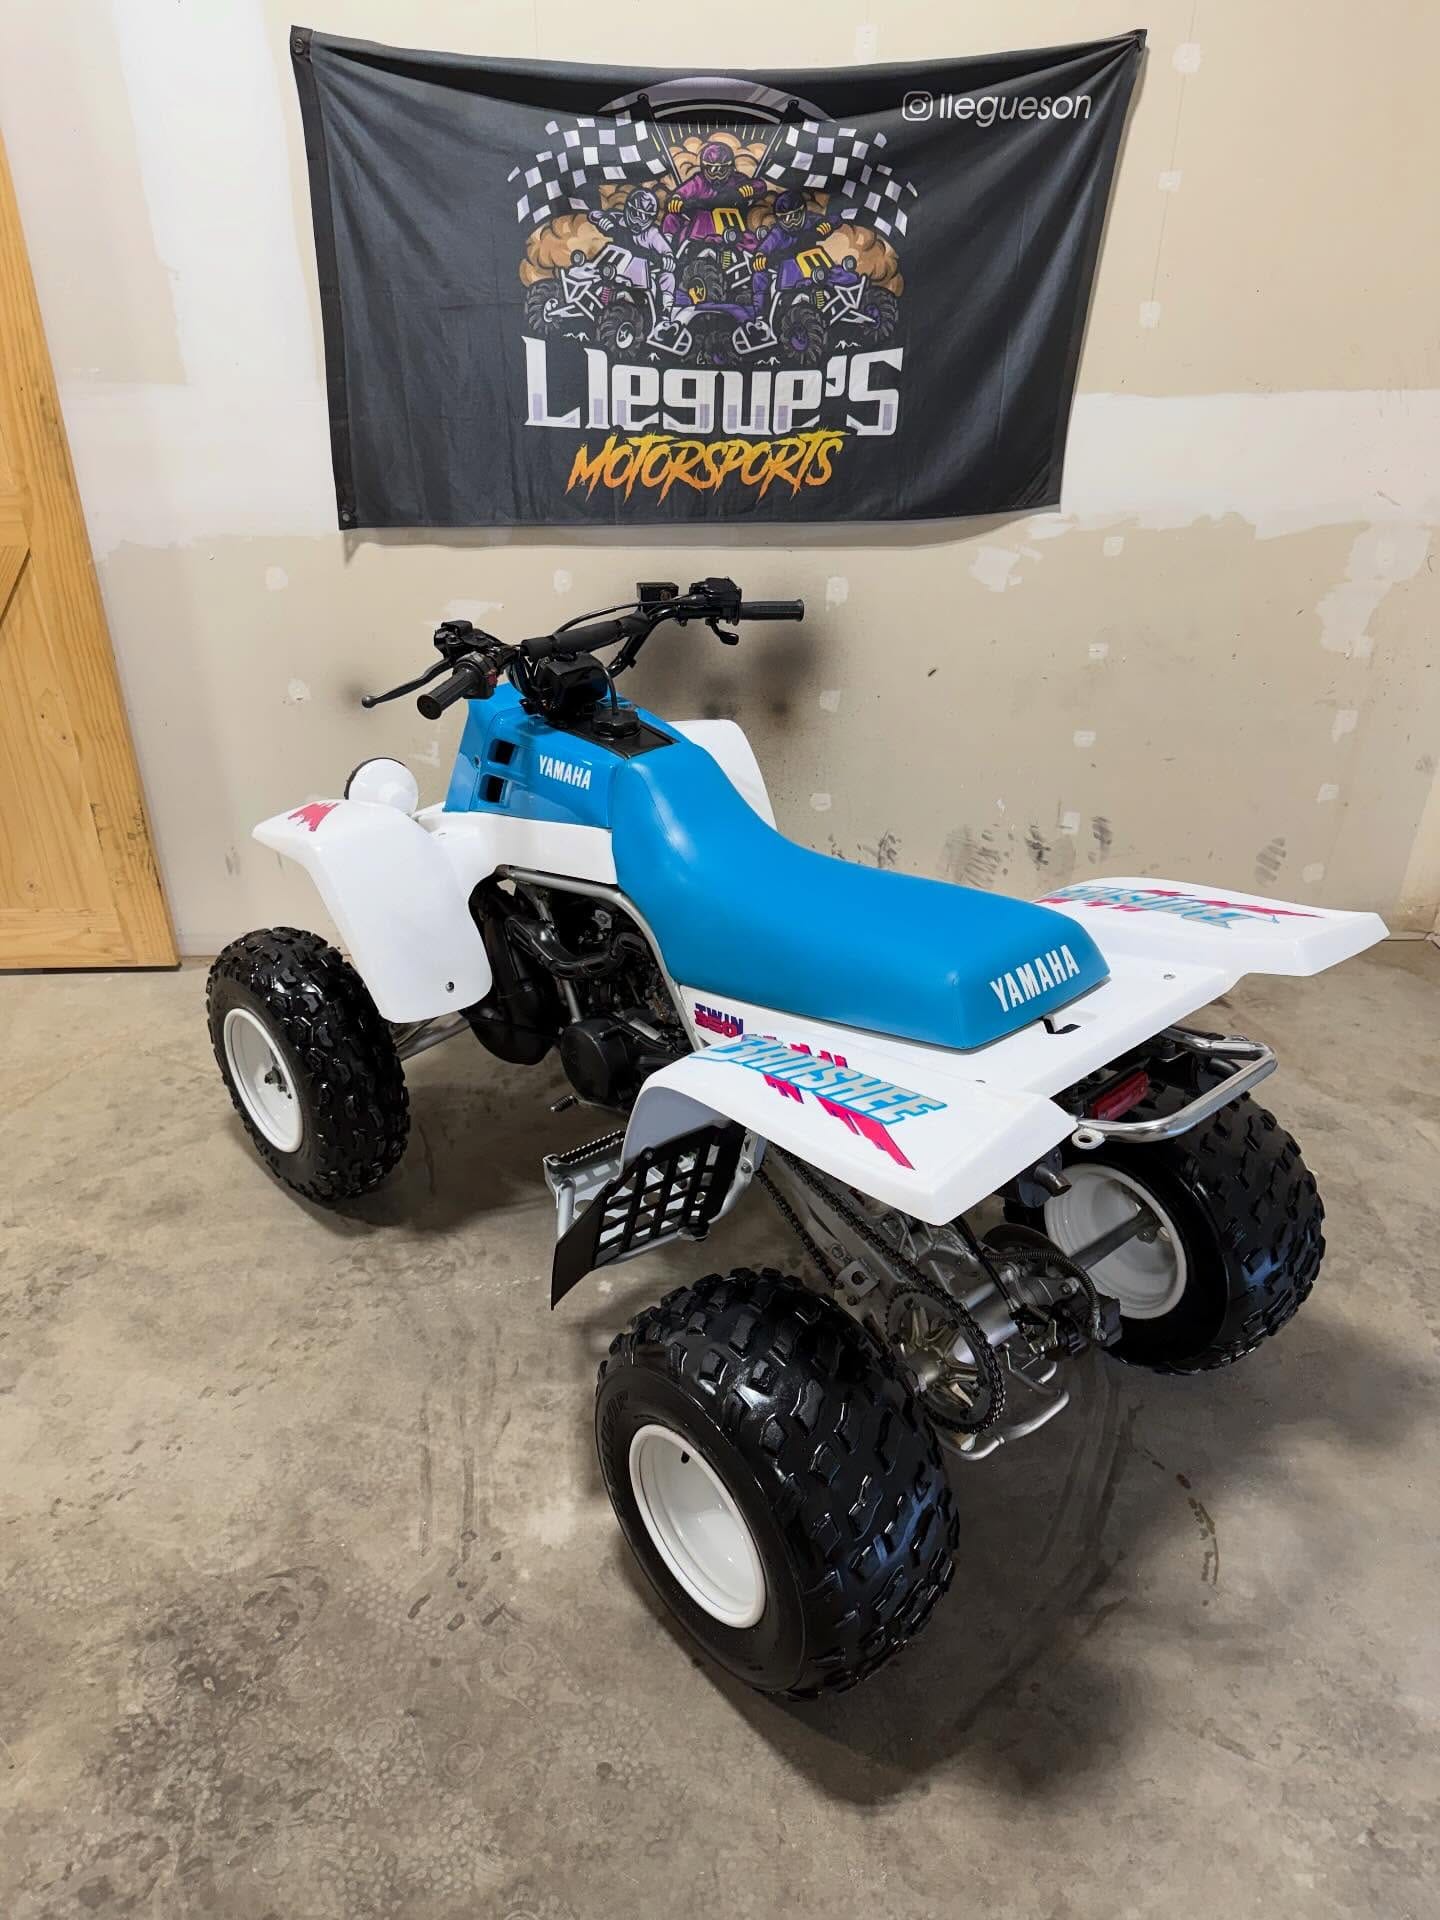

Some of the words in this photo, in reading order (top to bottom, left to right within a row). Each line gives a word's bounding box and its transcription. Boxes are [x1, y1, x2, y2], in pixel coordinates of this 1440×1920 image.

[564, 428, 850, 506] MOTORSPORTS
[539, 754, 592, 790] YAMAHA
[989, 944, 1081, 1013] YAMAHA
[694, 1002, 744, 1035] TWIN
